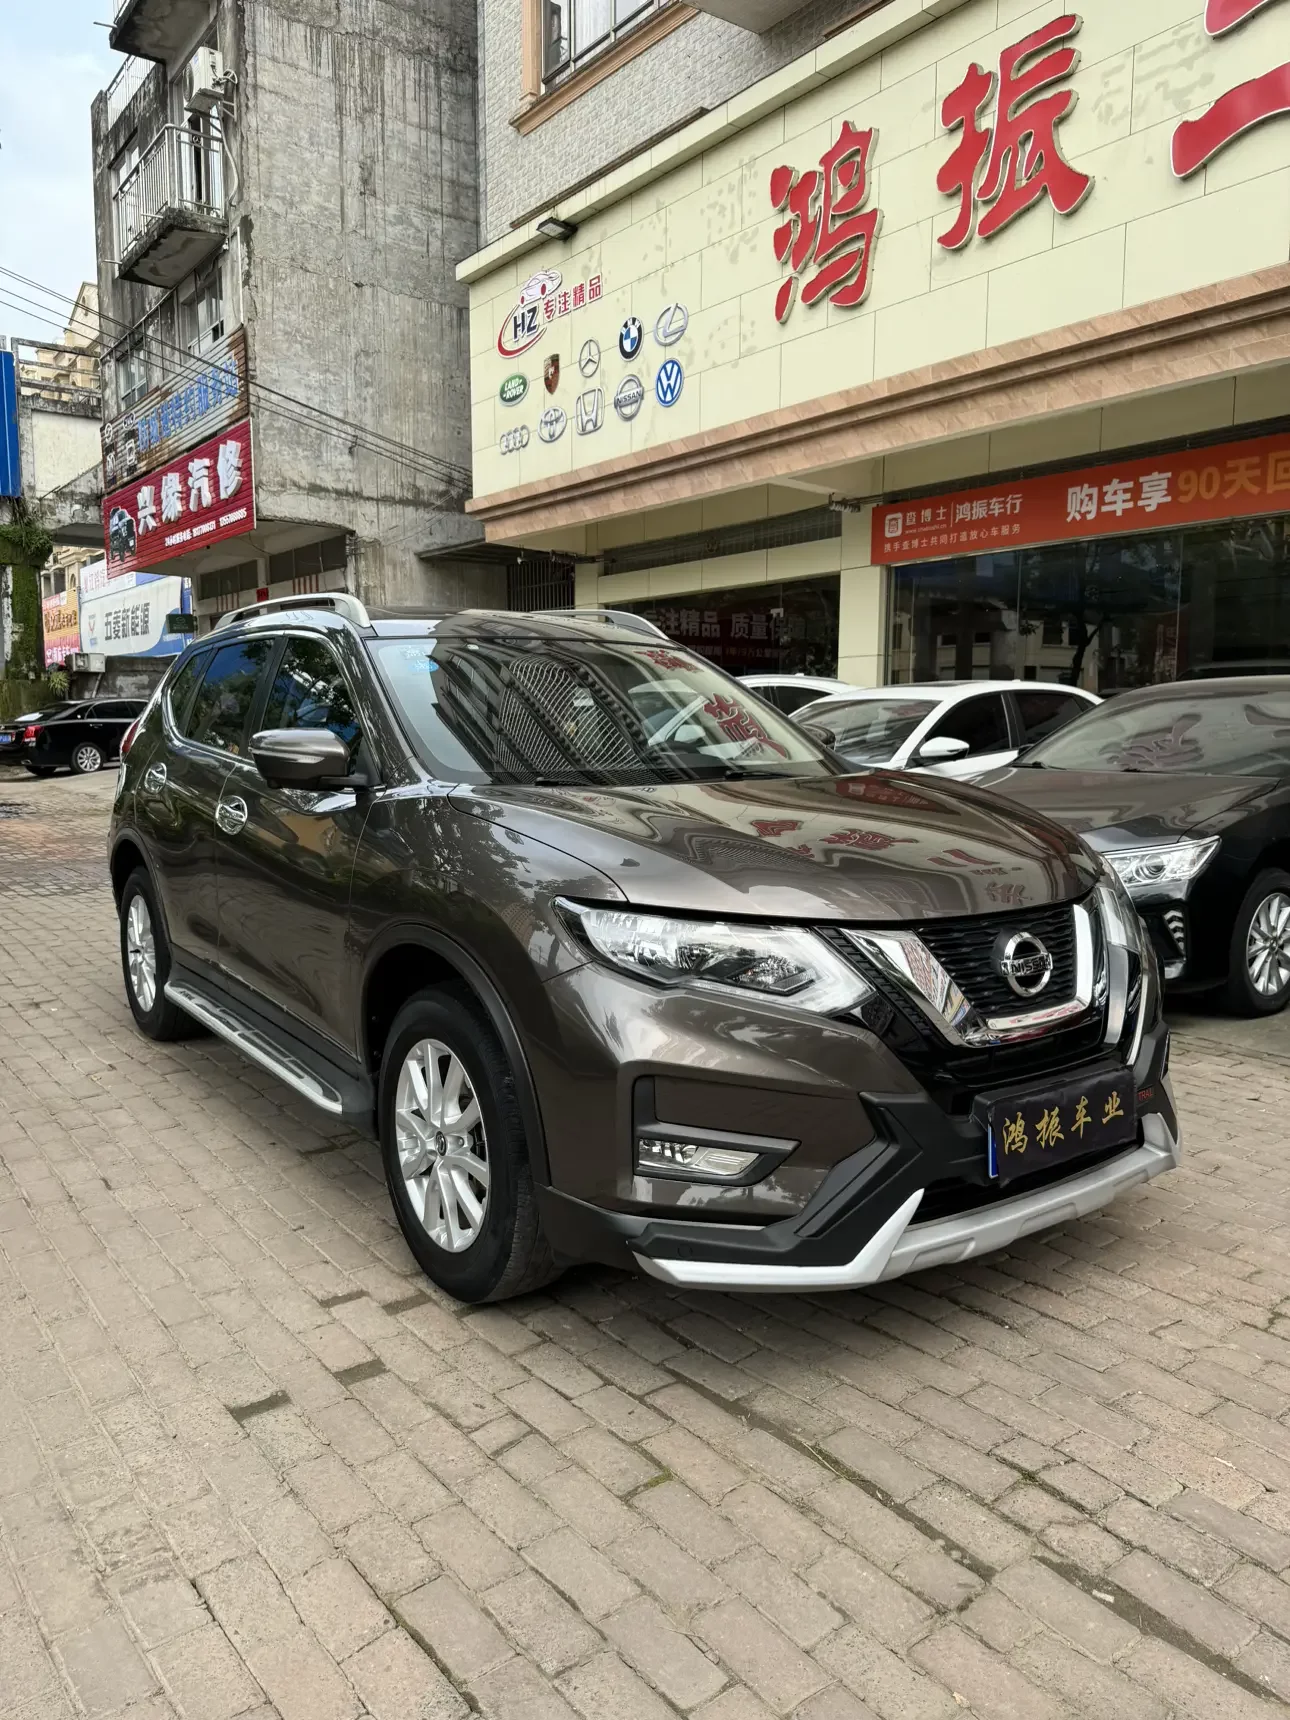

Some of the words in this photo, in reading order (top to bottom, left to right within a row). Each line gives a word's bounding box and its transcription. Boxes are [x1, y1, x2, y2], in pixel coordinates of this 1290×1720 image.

[543, 273, 602, 320] 专注精品
[513, 305, 538, 341] HZ
[616, 390, 642, 406] NISSAN
[137, 440, 242, 536] 兴缘汽修
[955, 493, 1023, 523] 鸿振车行
[104, 602, 150, 641] 五菱新能源
[1003, 1091, 1124, 1155] 鸿振车业
